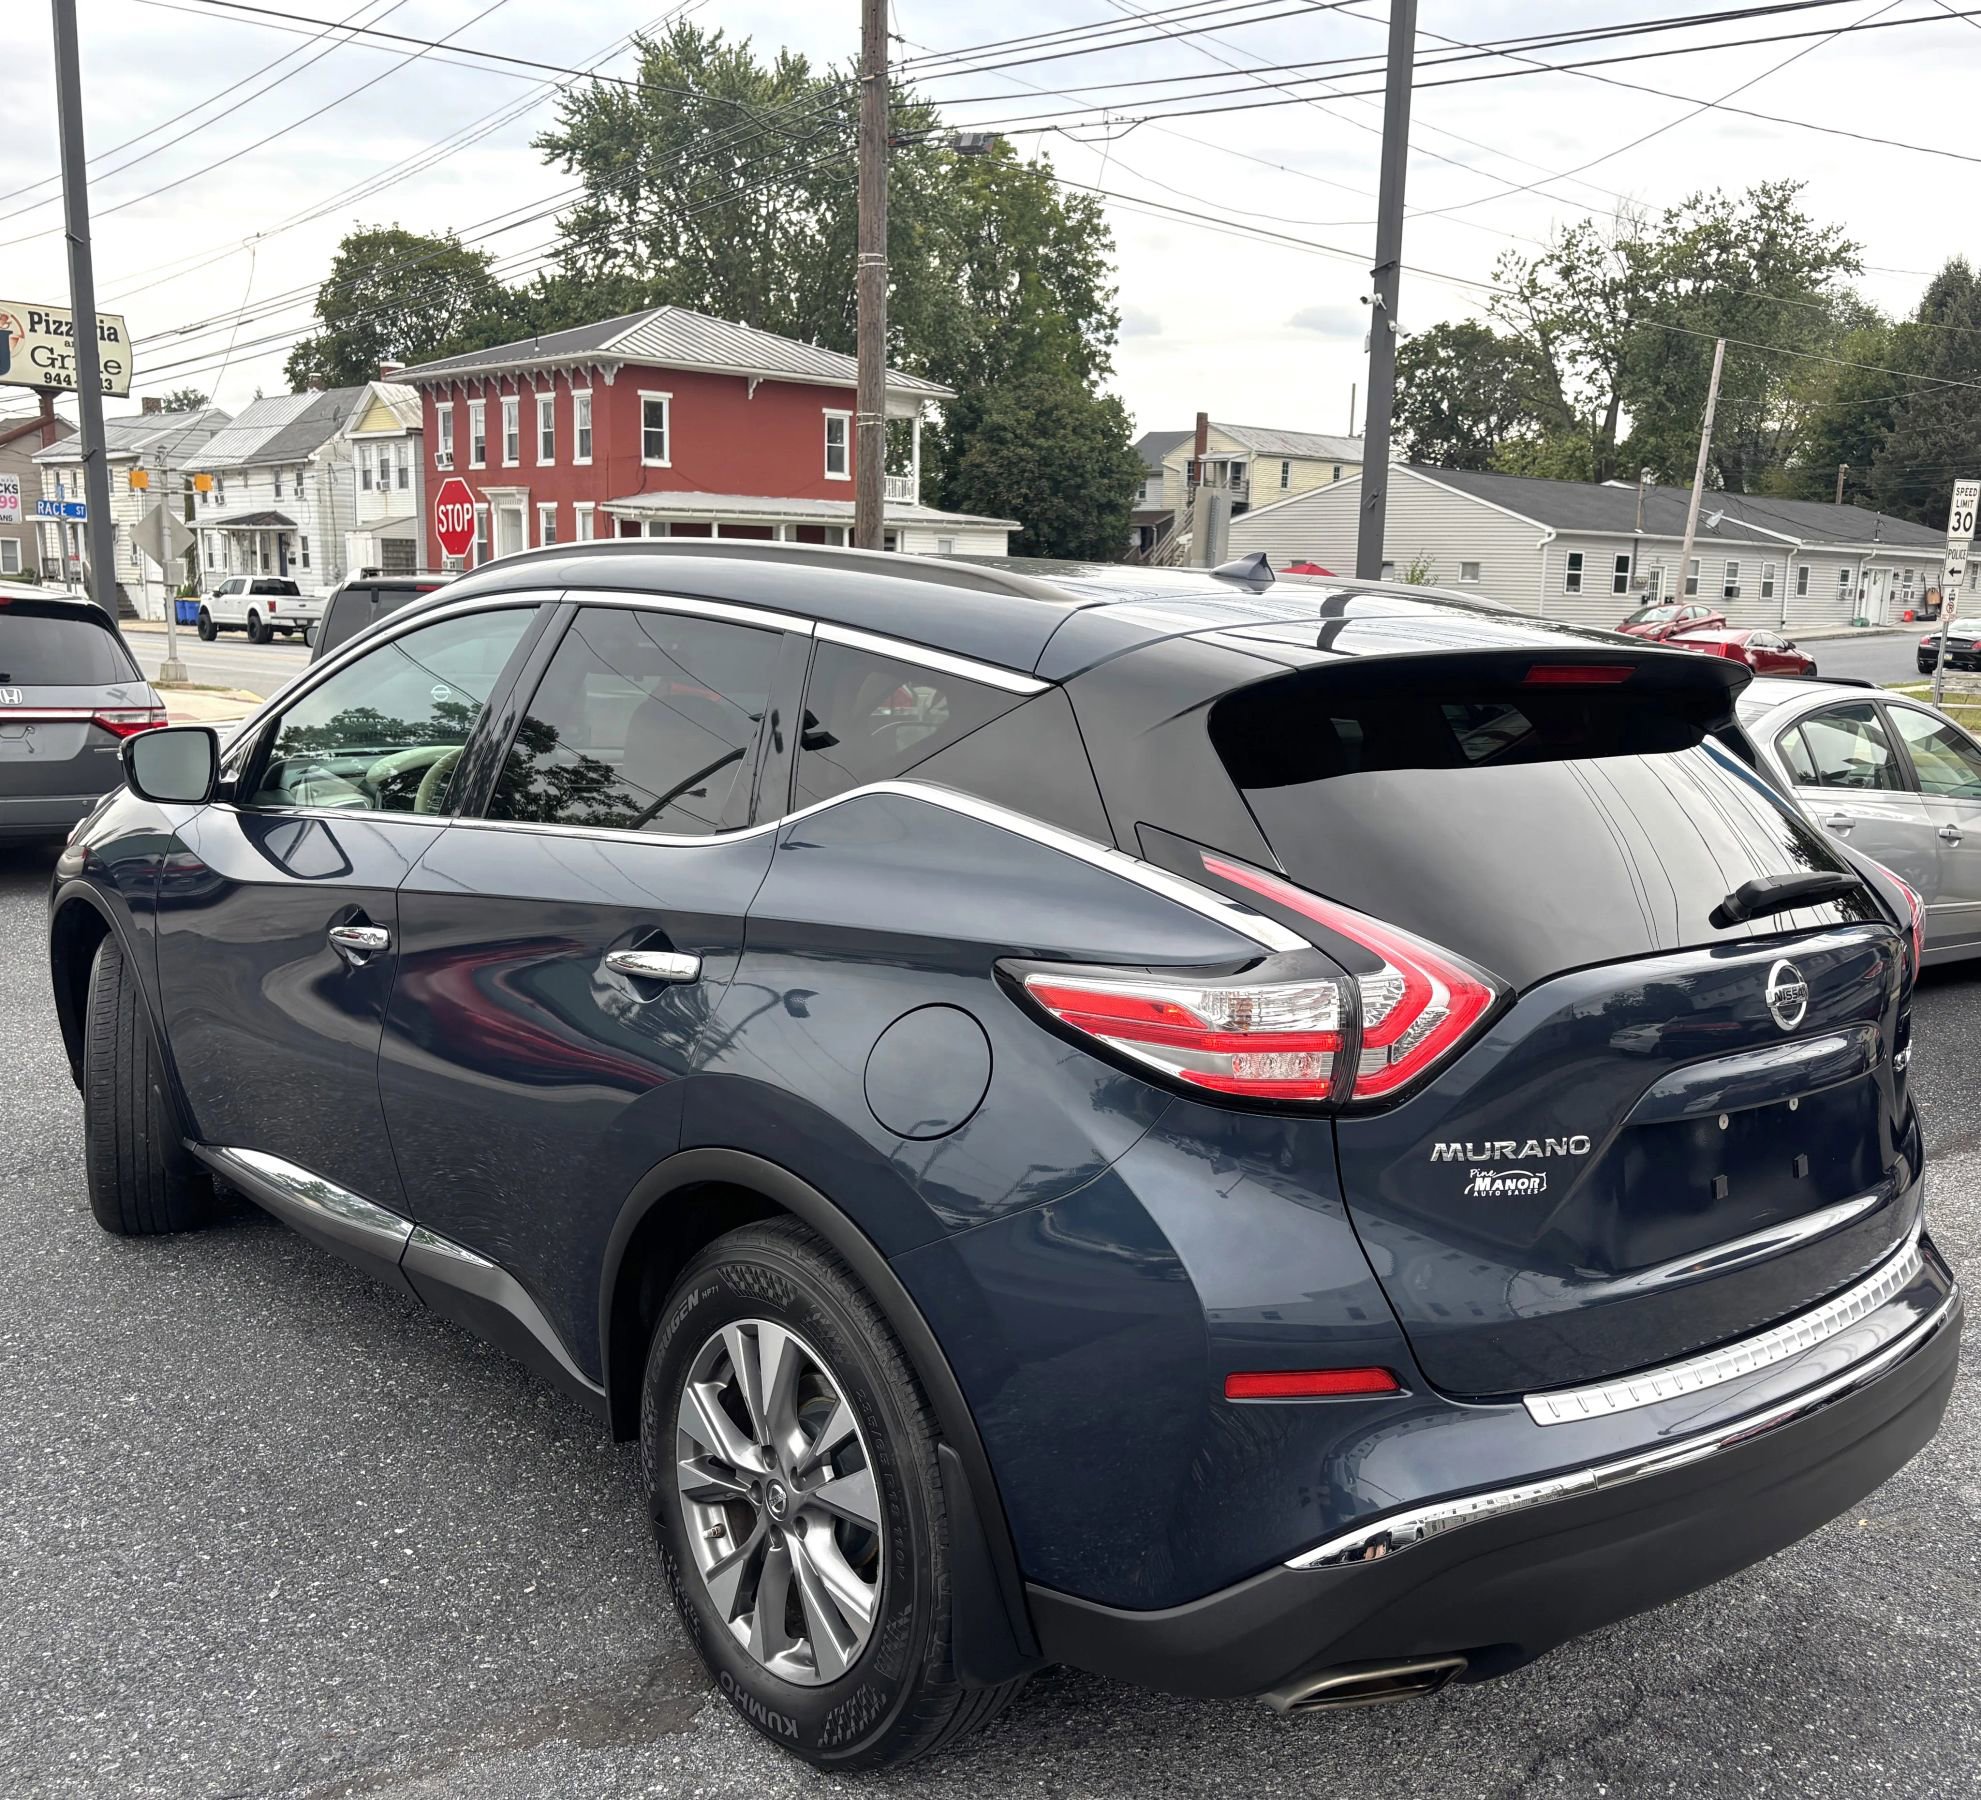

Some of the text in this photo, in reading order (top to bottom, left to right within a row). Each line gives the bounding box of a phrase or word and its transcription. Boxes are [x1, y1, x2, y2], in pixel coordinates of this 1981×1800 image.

[28, 311, 119, 343] Pizzia
[30, 345, 122, 375] Gre
[1955, 487, 1978, 497] SPEED
[37, 501, 85, 516] RACE ST
[1956, 499, 1974, 508] LIMIT
[438, 503, 473, 533] STOP
[1951, 511, 1973, 532] 30
[1947, 548, 1967, 560] POLICE
[1430, 1135, 1591, 1162] MURANO
[1469, 1168, 1497, 1179] Pine
[1473, 1177, 1541, 1192] MANOR
[1507, 1188, 1539, 1196] SALES
[701, 1285, 719, 1300] HP71
[720, 1670, 799, 1739] KUMHO
